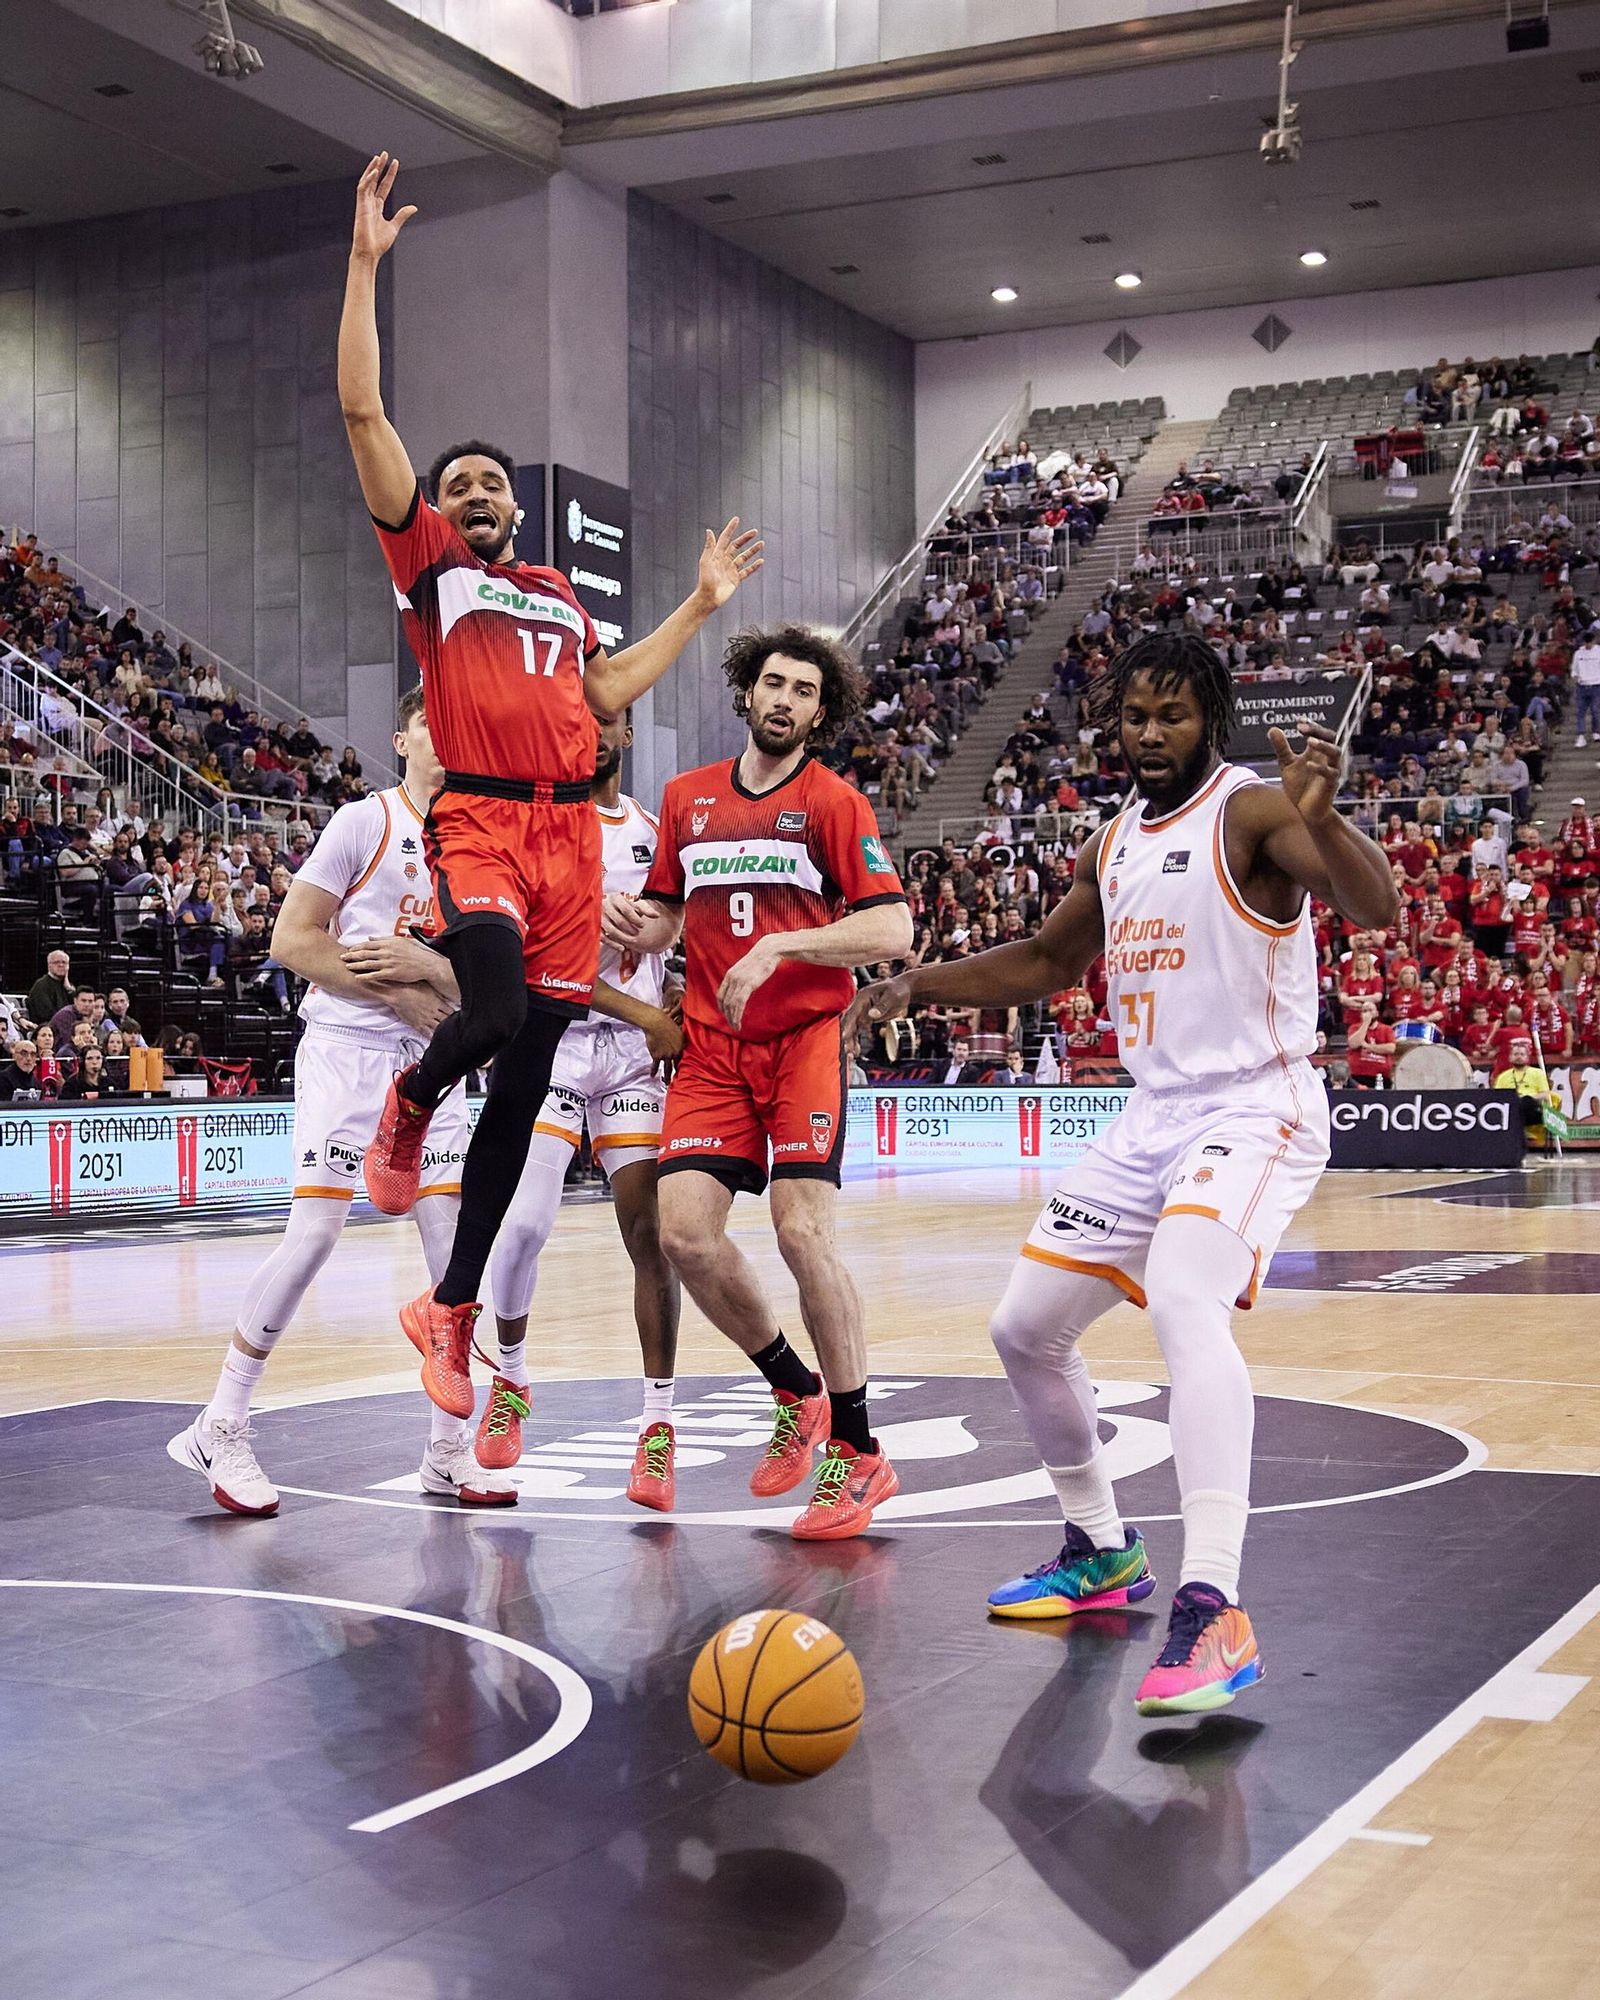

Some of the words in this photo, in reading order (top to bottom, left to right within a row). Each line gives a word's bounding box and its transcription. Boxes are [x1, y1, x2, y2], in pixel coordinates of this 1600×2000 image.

[517, 628, 563, 677] 17
[1235, 695, 1335, 710] AYUNTAMIENTO
[1242, 715, 1260, 726] DE
[729, 892, 754, 937] 9
[1167, 924, 1185, 939] del
[1118, 991, 1156, 1048] 37
[905, 1096, 1004, 1112] GRANADA
[1049, 1096, 1128, 1112] GRANA
[1331, 1094, 1510, 1131] endesa
[80, 1116, 172, 1143] GRANADA
[204, 1113, 287, 1138] GRANADA
[906, 1118, 949, 1137] 2031
[1050, 1118, 1095, 1138] 2031
[80, 1153, 122, 1181] 2031
[204, 1147, 243, 1174] 2031
[1047, 1197, 1106, 1231] PULEVA
